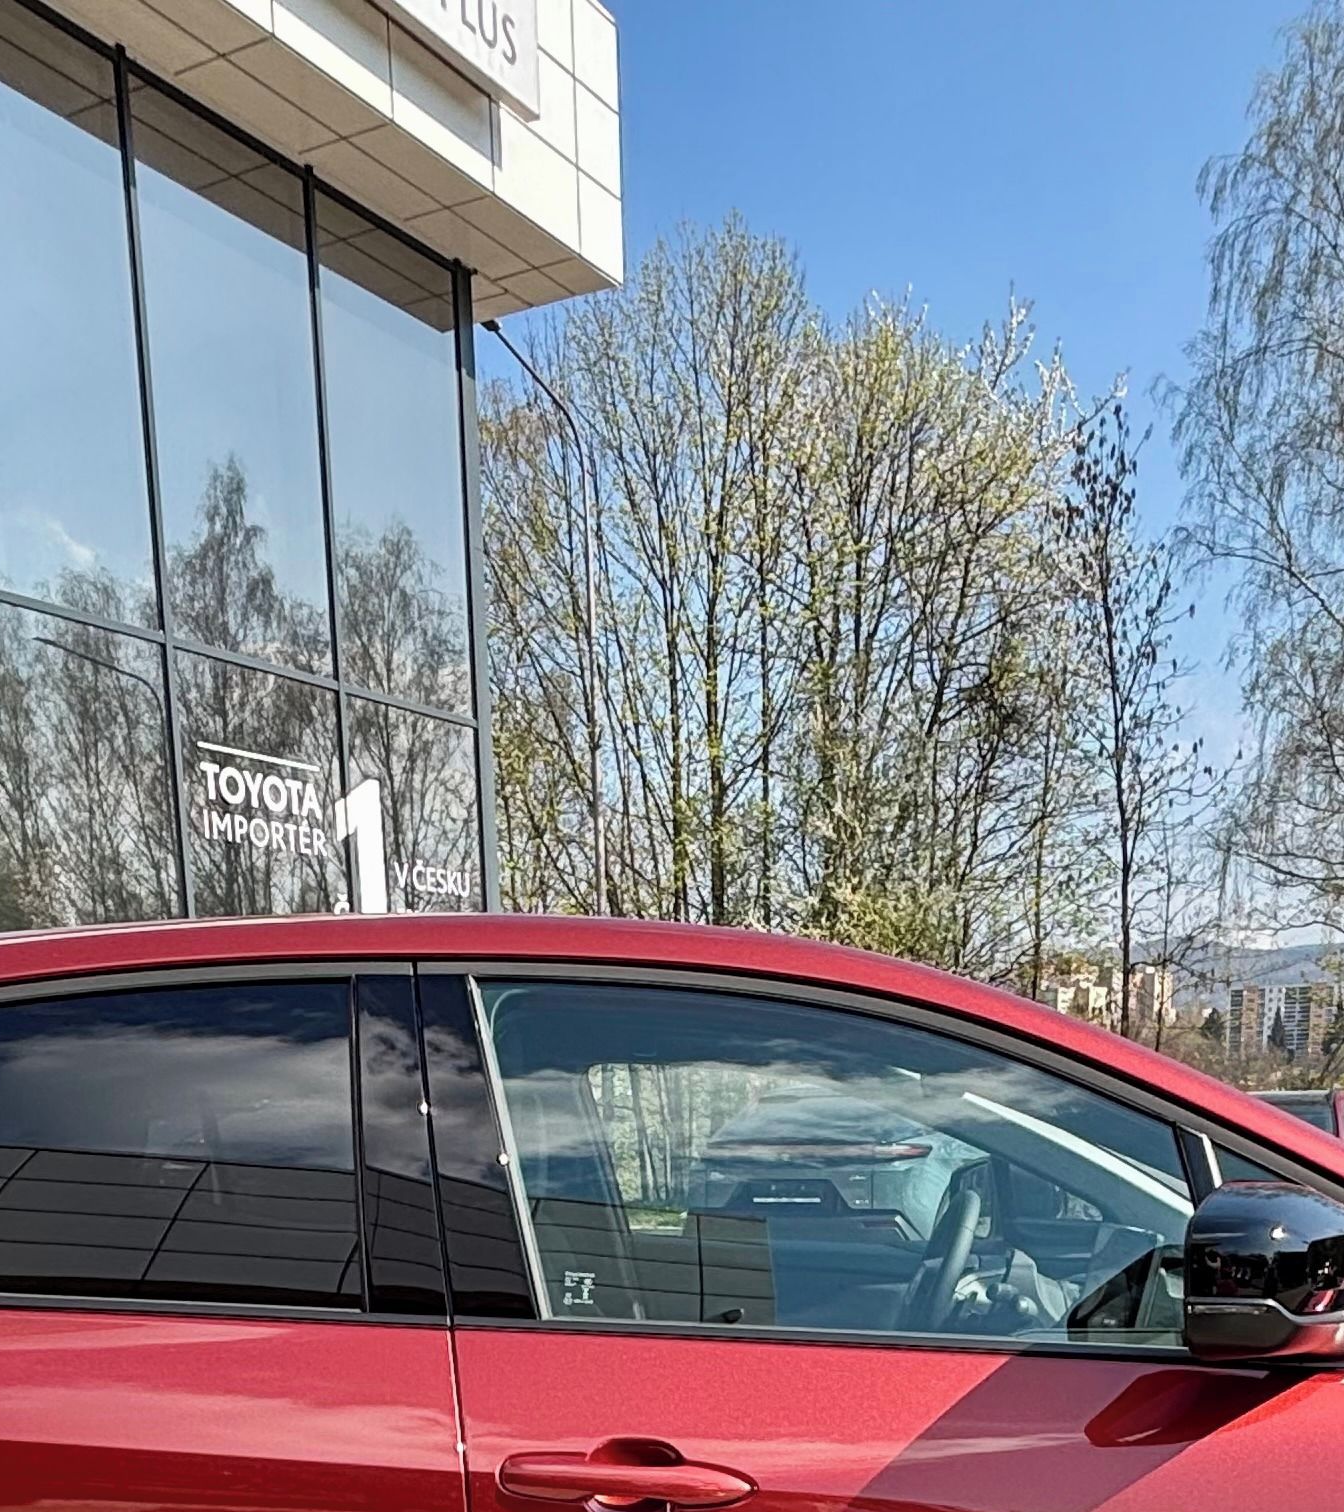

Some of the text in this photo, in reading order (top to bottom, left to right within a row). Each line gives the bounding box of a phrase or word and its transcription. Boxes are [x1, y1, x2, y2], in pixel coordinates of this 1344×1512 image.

[440, 0, 517, 66] LUS
[199, 760, 323, 821] TOYOTA
[202, 808, 329, 857] IMPORTÉR
[412, 858, 471, 898] ČESKU
